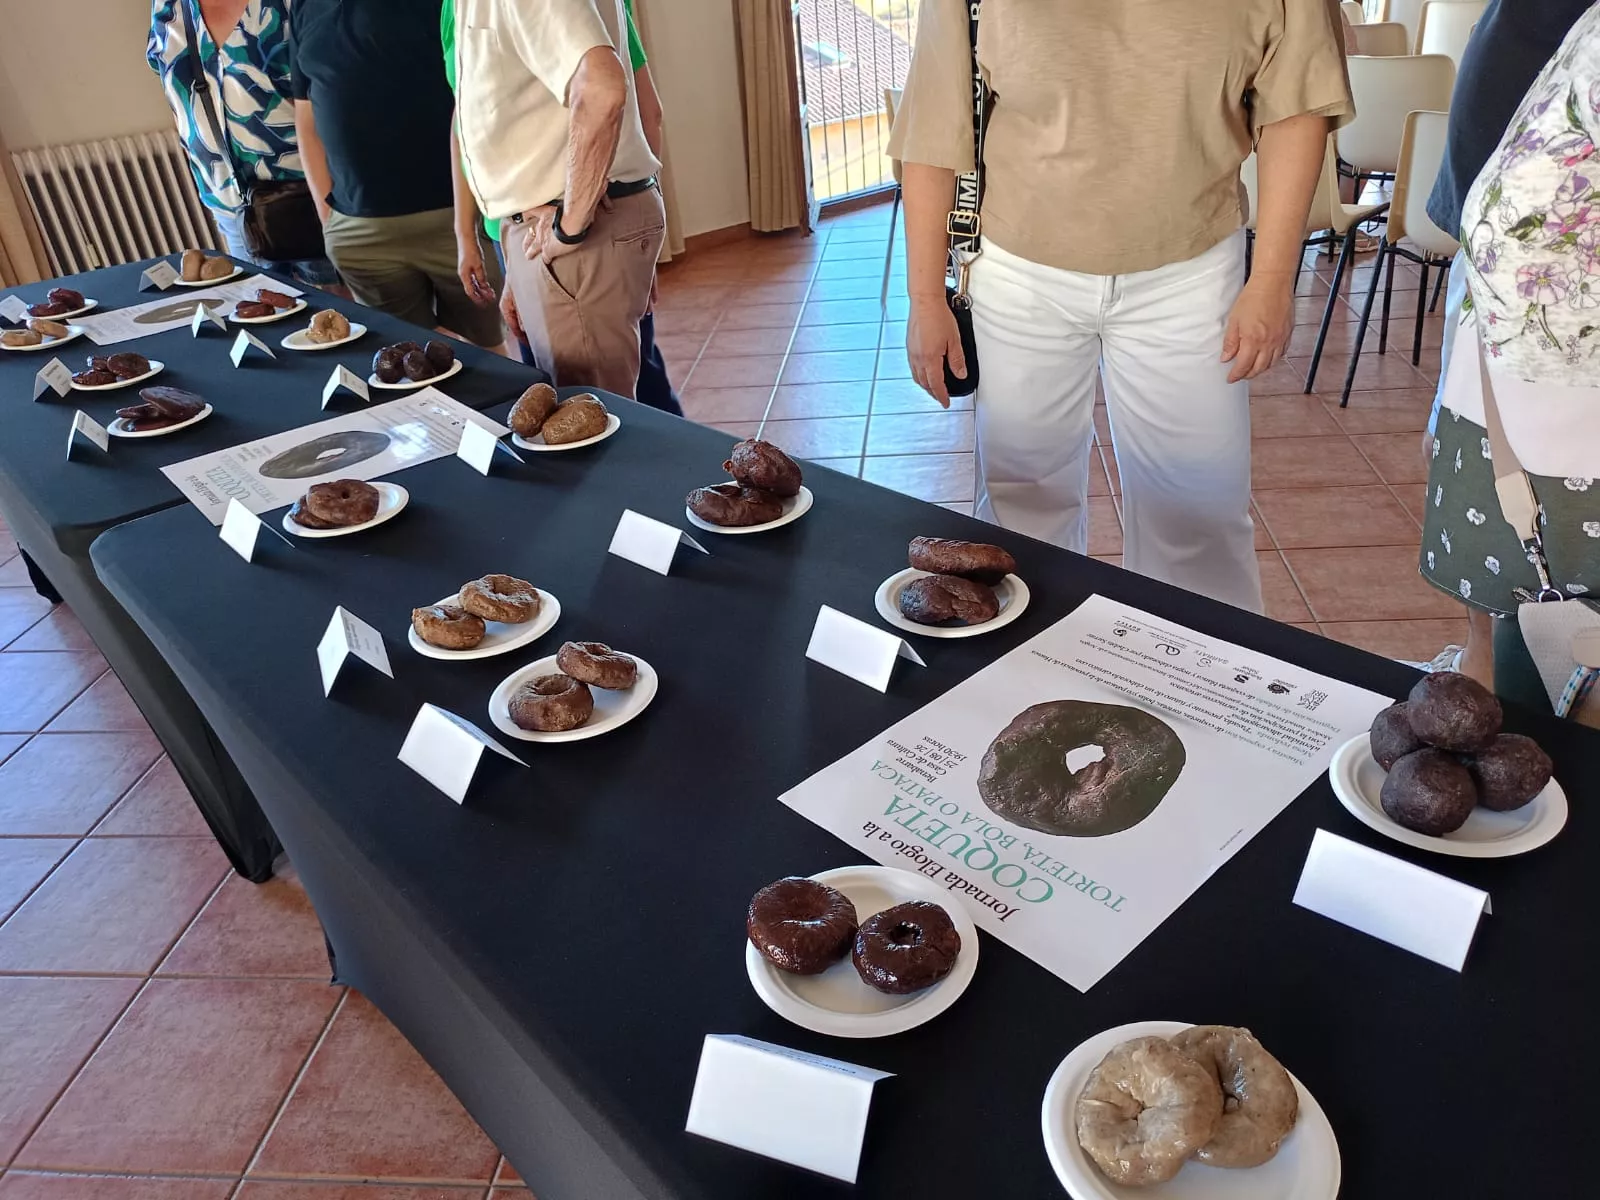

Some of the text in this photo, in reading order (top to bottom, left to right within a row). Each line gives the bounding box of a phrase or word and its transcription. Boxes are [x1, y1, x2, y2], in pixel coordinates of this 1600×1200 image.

[205, 465, 250, 501] COQUETA
[1249, 712, 1300, 735] participación
[913, 743, 928, 753] 26
[921, 735, 967, 762] 19:30 horas
[1280, 733, 1320, 751] identidad
[1307, 736, 1326, 746] Con
[886, 739, 947, 775] Casa de Cultura
[928, 751, 942, 761] 08
[942, 759, 958, 769] 25
[895, 757, 937, 783] Benabarre
[871, 759, 1124, 912] TORTETA, BOLA O PATACA
[884, 795, 1052, 902] COQUETA
[862, 820, 1019, 921] Jornada Elogio a la
